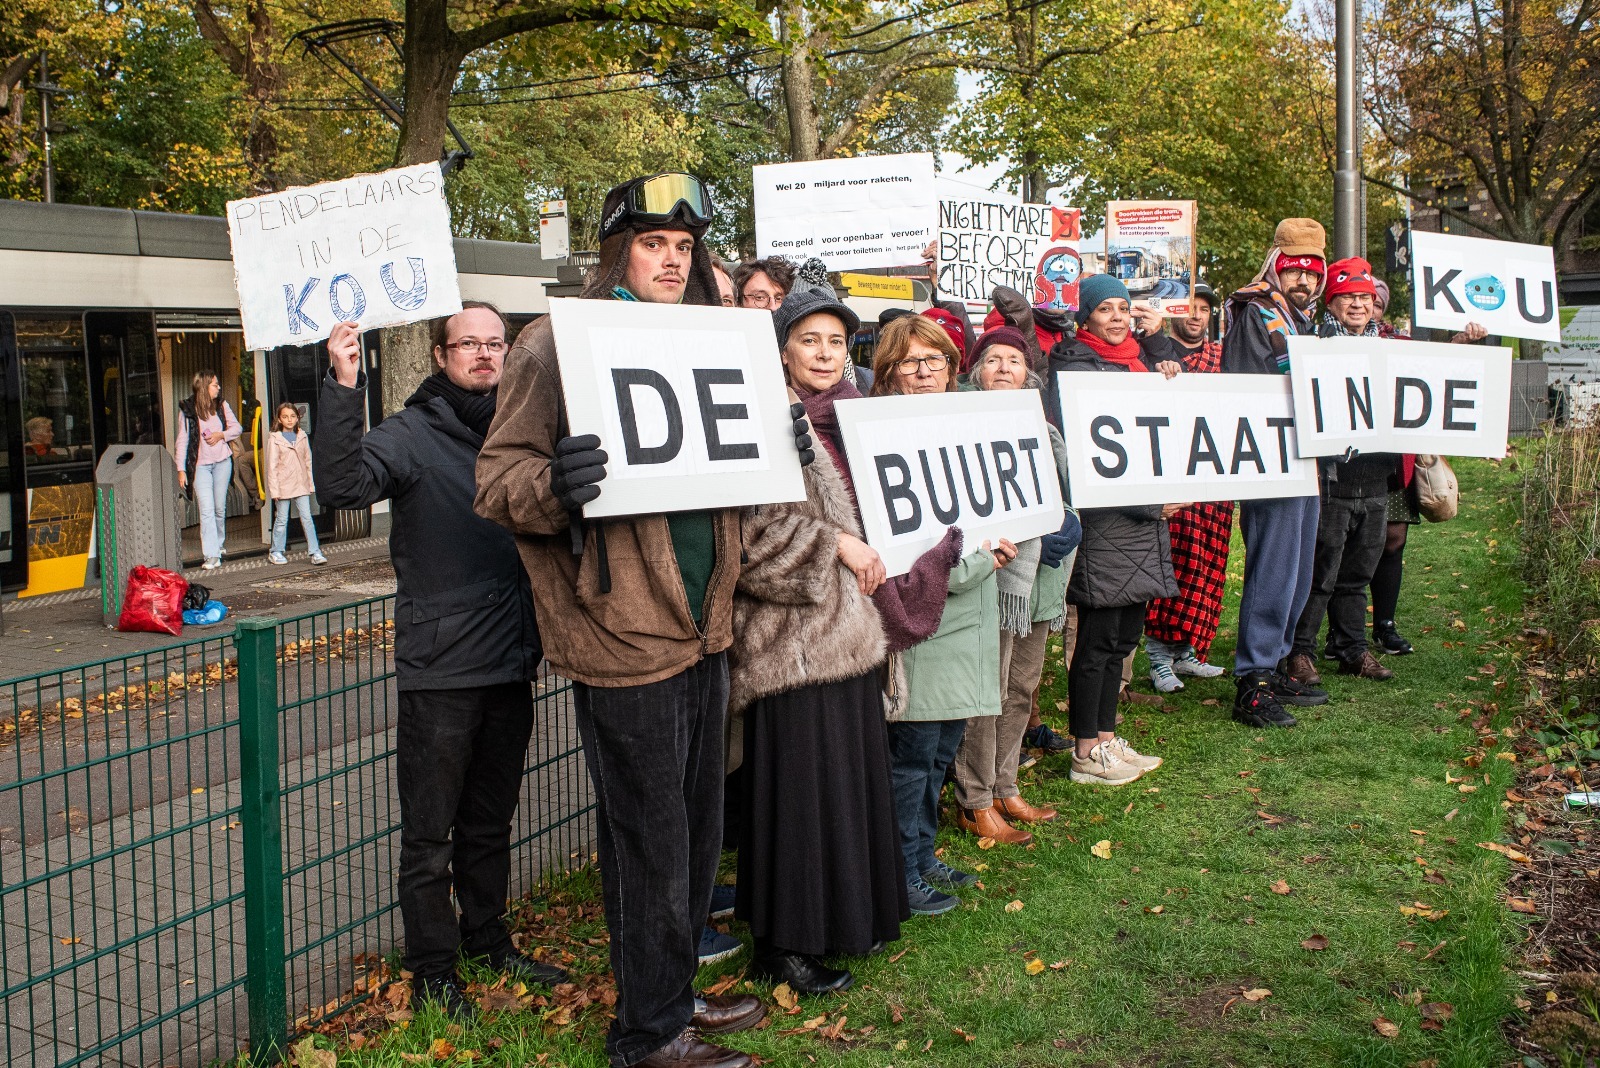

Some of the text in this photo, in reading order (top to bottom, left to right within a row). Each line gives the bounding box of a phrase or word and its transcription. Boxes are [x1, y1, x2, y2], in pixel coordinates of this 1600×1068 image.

[235, 171, 436, 235] PENDELAARS
[795, 182, 806, 190] 20
[814, 179, 845, 188] miljard
[848, 178, 868, 186] voor
[870, 175, 912, 184] raketten,
[604, 201, 626, 231] SINNER
[772, 240, 793, 248] Geen
[795, 238, 813, 247] geld
[822, 236, 841, 244] voor
[843, 232, 883, 244] openbaar
[891, 230, 924, 238] vervoer
[359, 224, 413, 258] DE
[853, 246, 883, 254] toiletten
[940, 232, 1038, 270] BEFORE
[283, 257, 428, 335] KOU
[611, 368, 760, 465] DE
[1311, 376, 1478, 433] IN DE
[1090, 415, 1294, 478] STAAT
[874, 438, 1043, 536] BUURT
